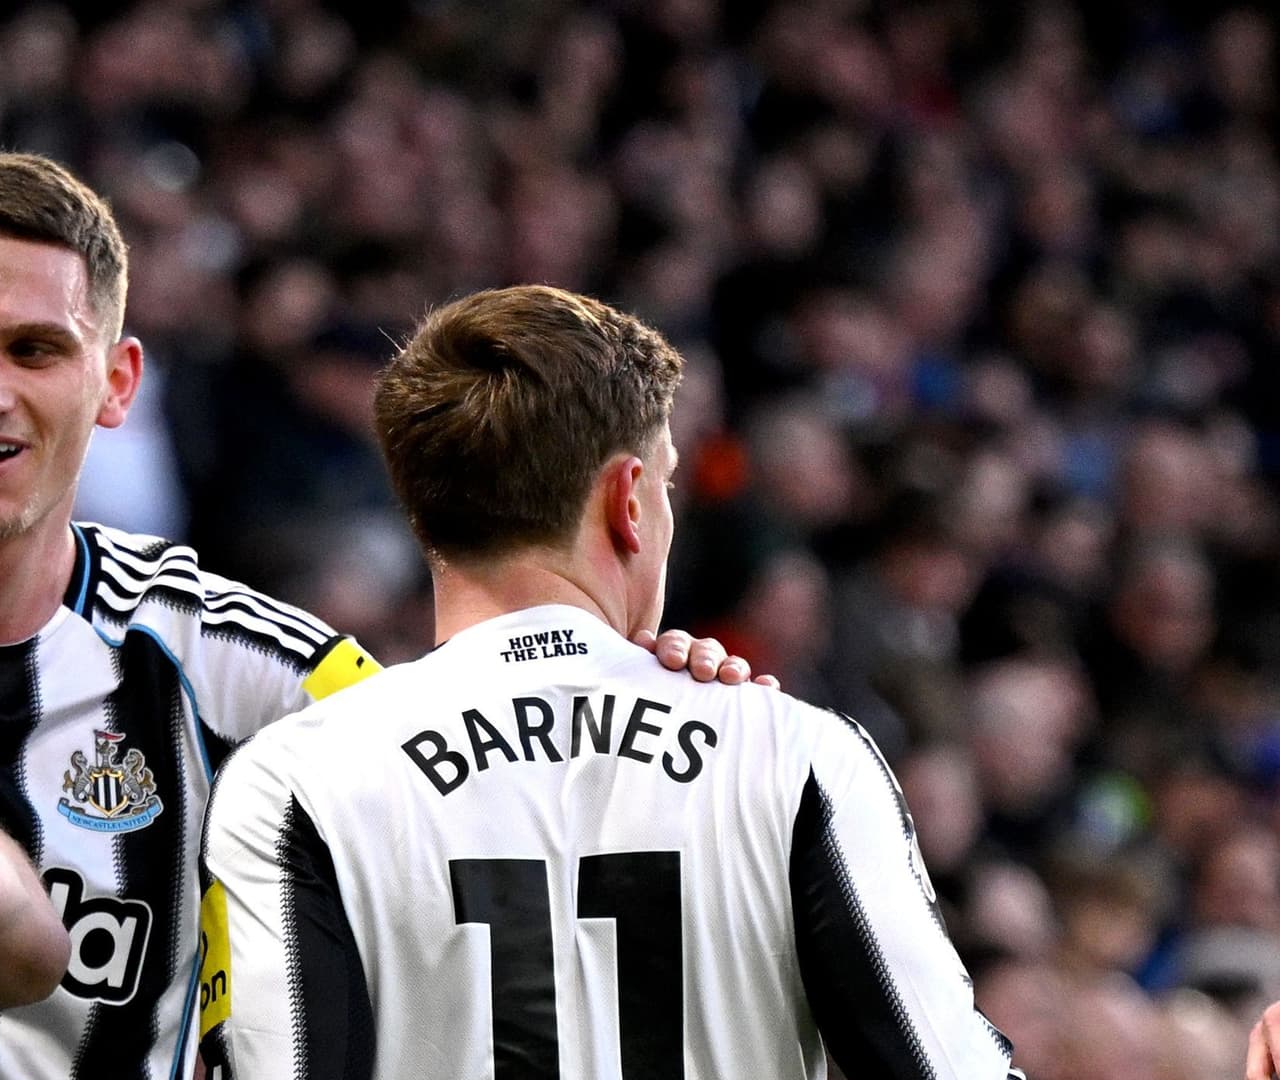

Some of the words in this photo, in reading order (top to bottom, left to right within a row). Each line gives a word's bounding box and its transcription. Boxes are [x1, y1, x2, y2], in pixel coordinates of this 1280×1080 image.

[508, 629, 574, 650] HOWAY
[500, 647, 538, 663] THE
[541, 642, 588, 658] LADS
[402, 694, 717, 797] BARNES
